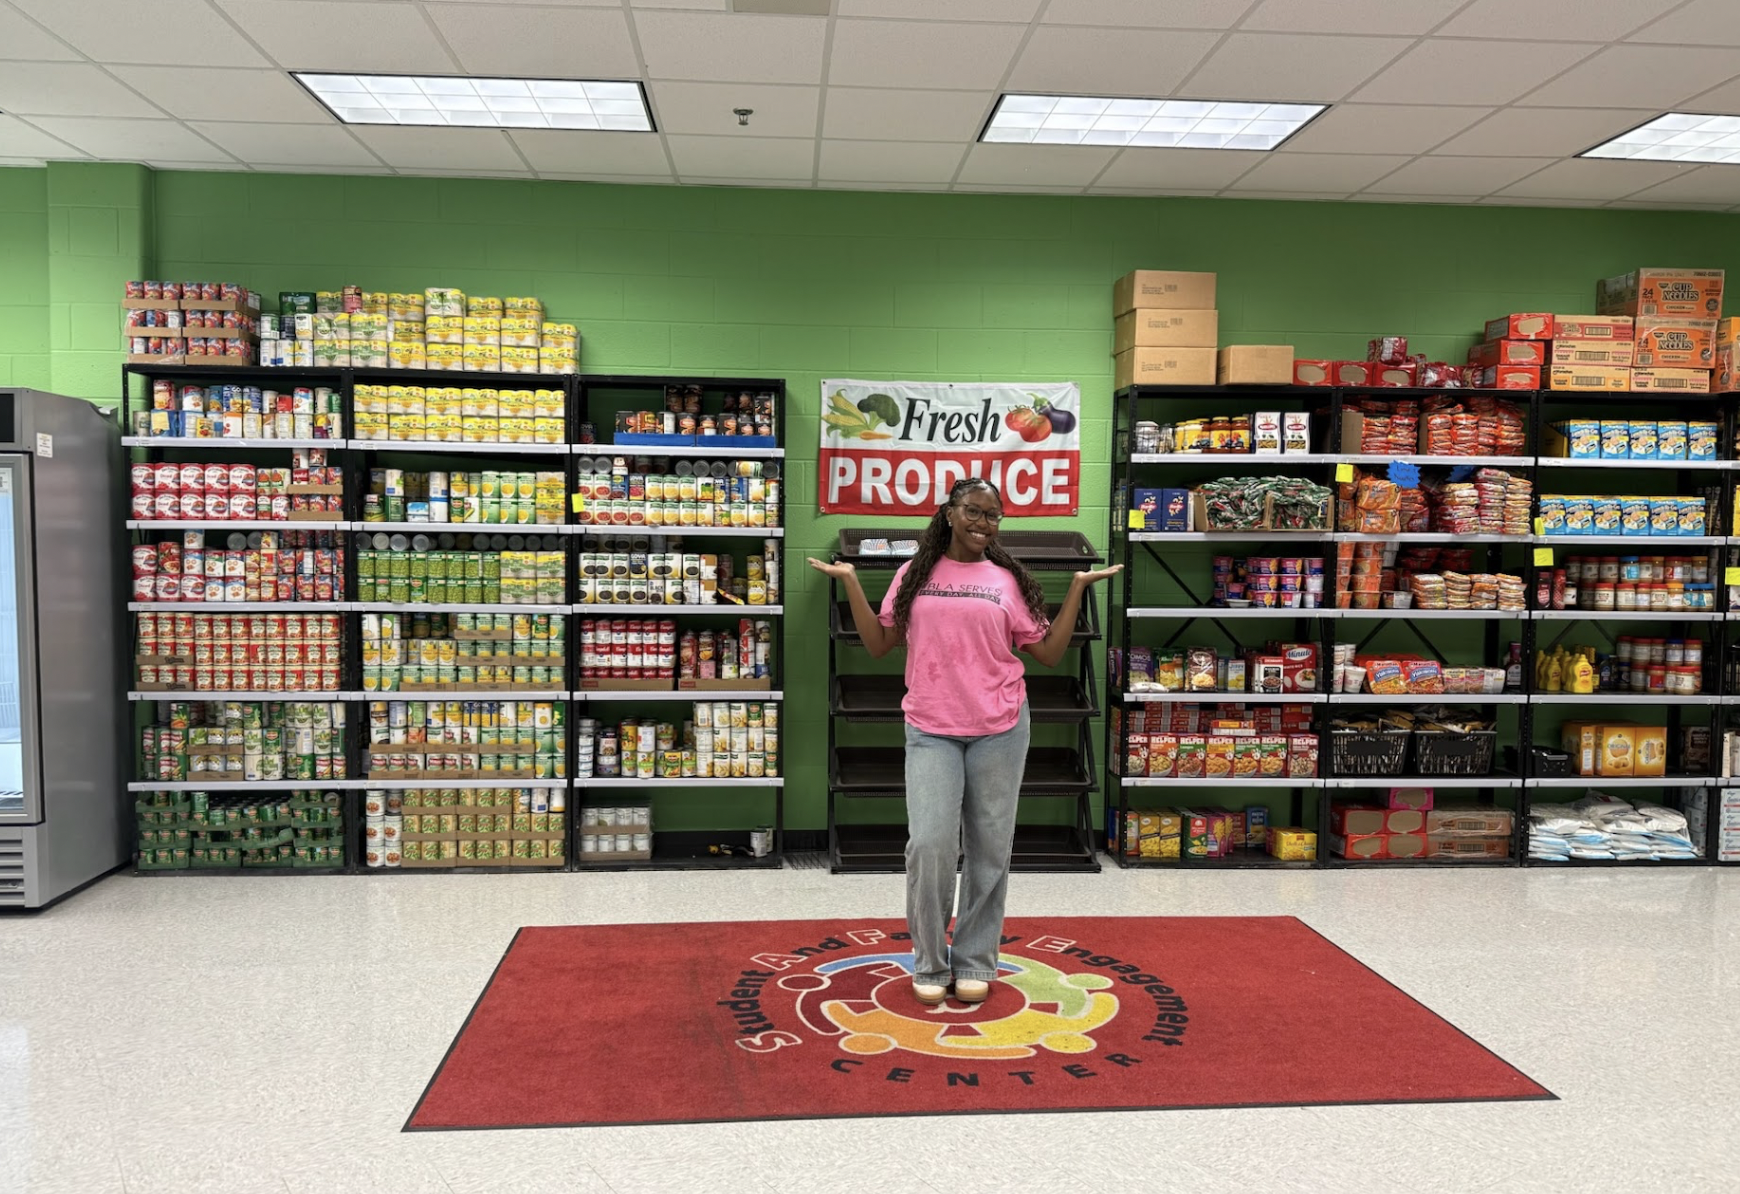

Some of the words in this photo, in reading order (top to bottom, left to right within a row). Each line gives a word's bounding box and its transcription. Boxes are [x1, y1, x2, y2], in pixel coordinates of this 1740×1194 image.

[1643, 288, 1653, 296] 24
[1672, 283, 1692, 292] CUP
[1663, 291, 1699, 301] NOODLES
[1667, 332, 1688, 341] CUP
[1658, 340, 1693, 350] NOODLES
[898, 397, 1002, 443] Fresh
[926, 582, 954, 591] BLA
[958, 584, 1003, 597] SERVES
[1287, 648, 1313, 659] Minute
[1128, 735, 1148, 744] ELPER
[1151, 735, 1176, 744] HELPER
[1180, 736, 1205, 745] HELPER
[1208, 737, 1234, 745] HELPER
[1236, 737, 1260, 745] HELPER
[1262, 736, 1286, 744] HELPER
[1292, 738, 1317, 746] HELPER
[750, 937, 851, 971] And
[1026, 935, 1189, 1046] Engagement
[717, 970, 802, 1052] Student
[831, 1053, 1142, 1087] CENTER
